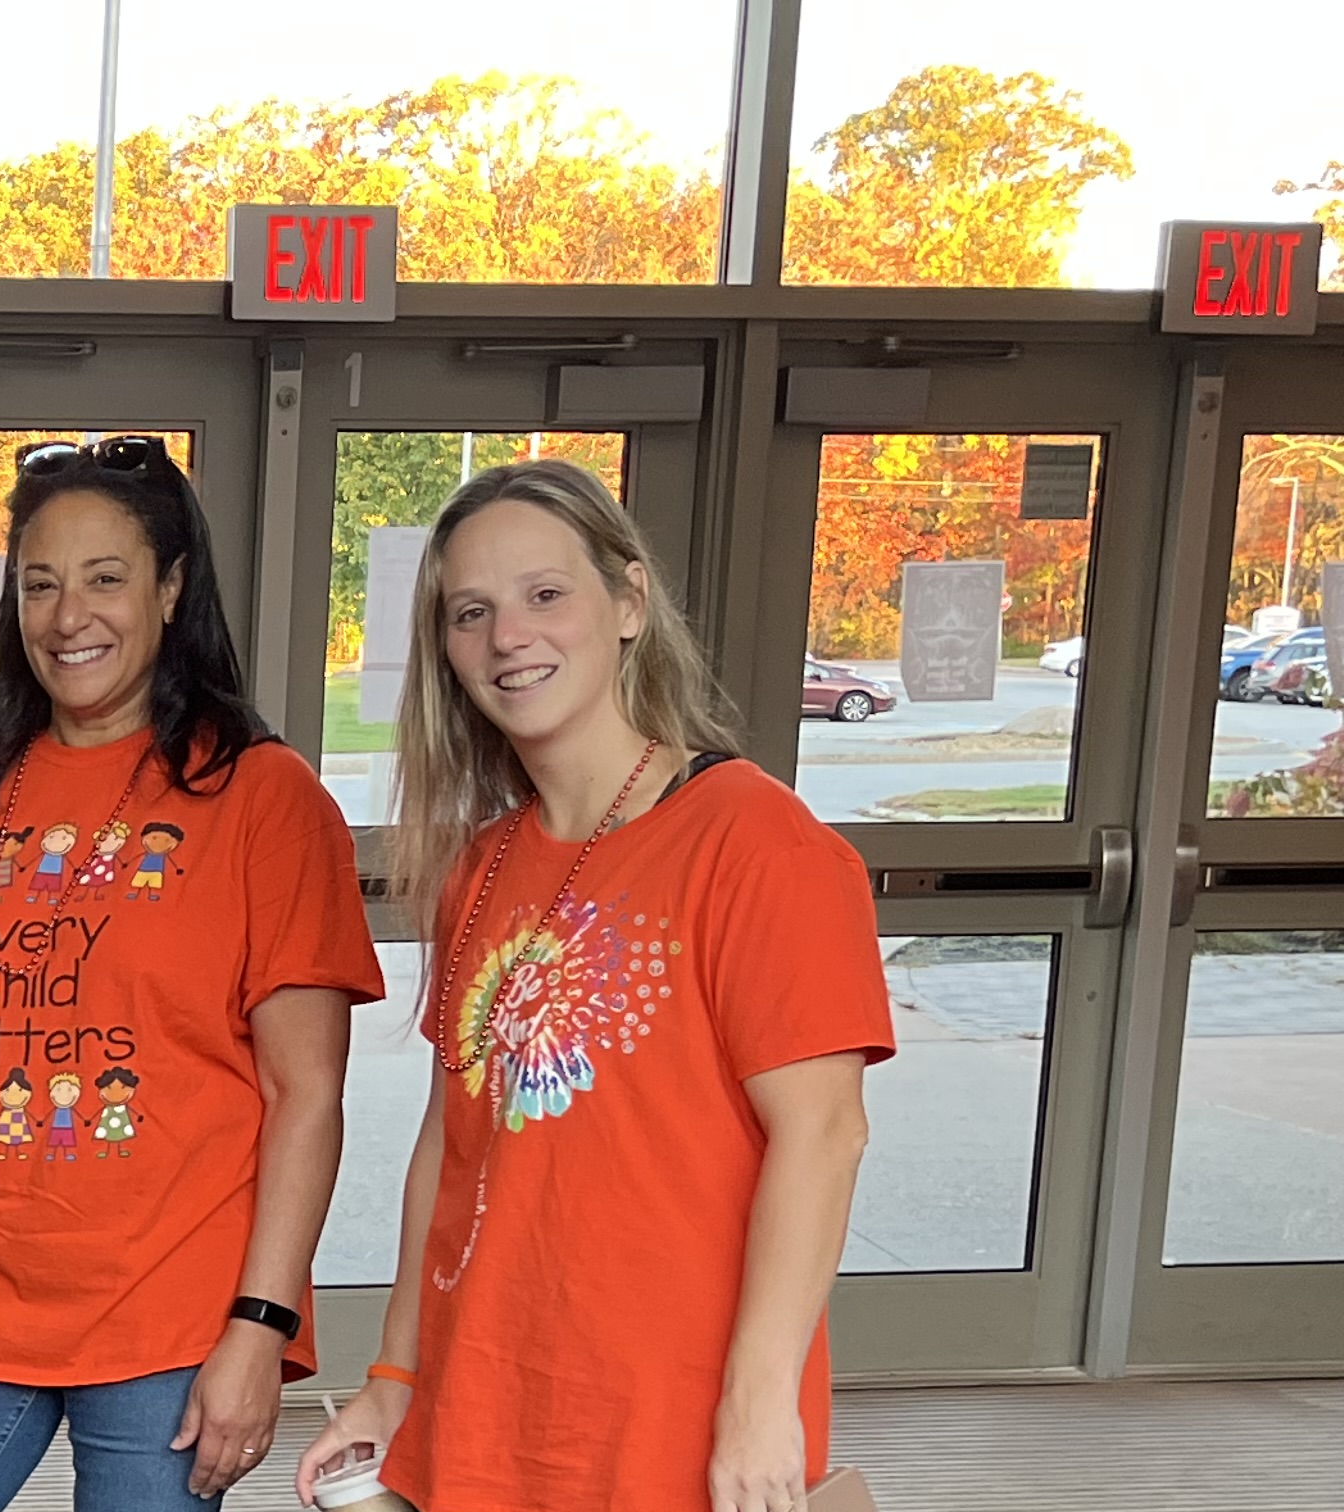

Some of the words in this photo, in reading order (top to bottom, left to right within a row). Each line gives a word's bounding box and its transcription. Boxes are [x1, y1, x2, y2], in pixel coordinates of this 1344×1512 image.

[265, 215, 375, 304] EXIT
[1193, 230, 1303, 317] EXIT
[344, 352, 362, 407] 1
[505, 963, 543, 1010] Be
[492, 1003, 551, 1051] Kind
